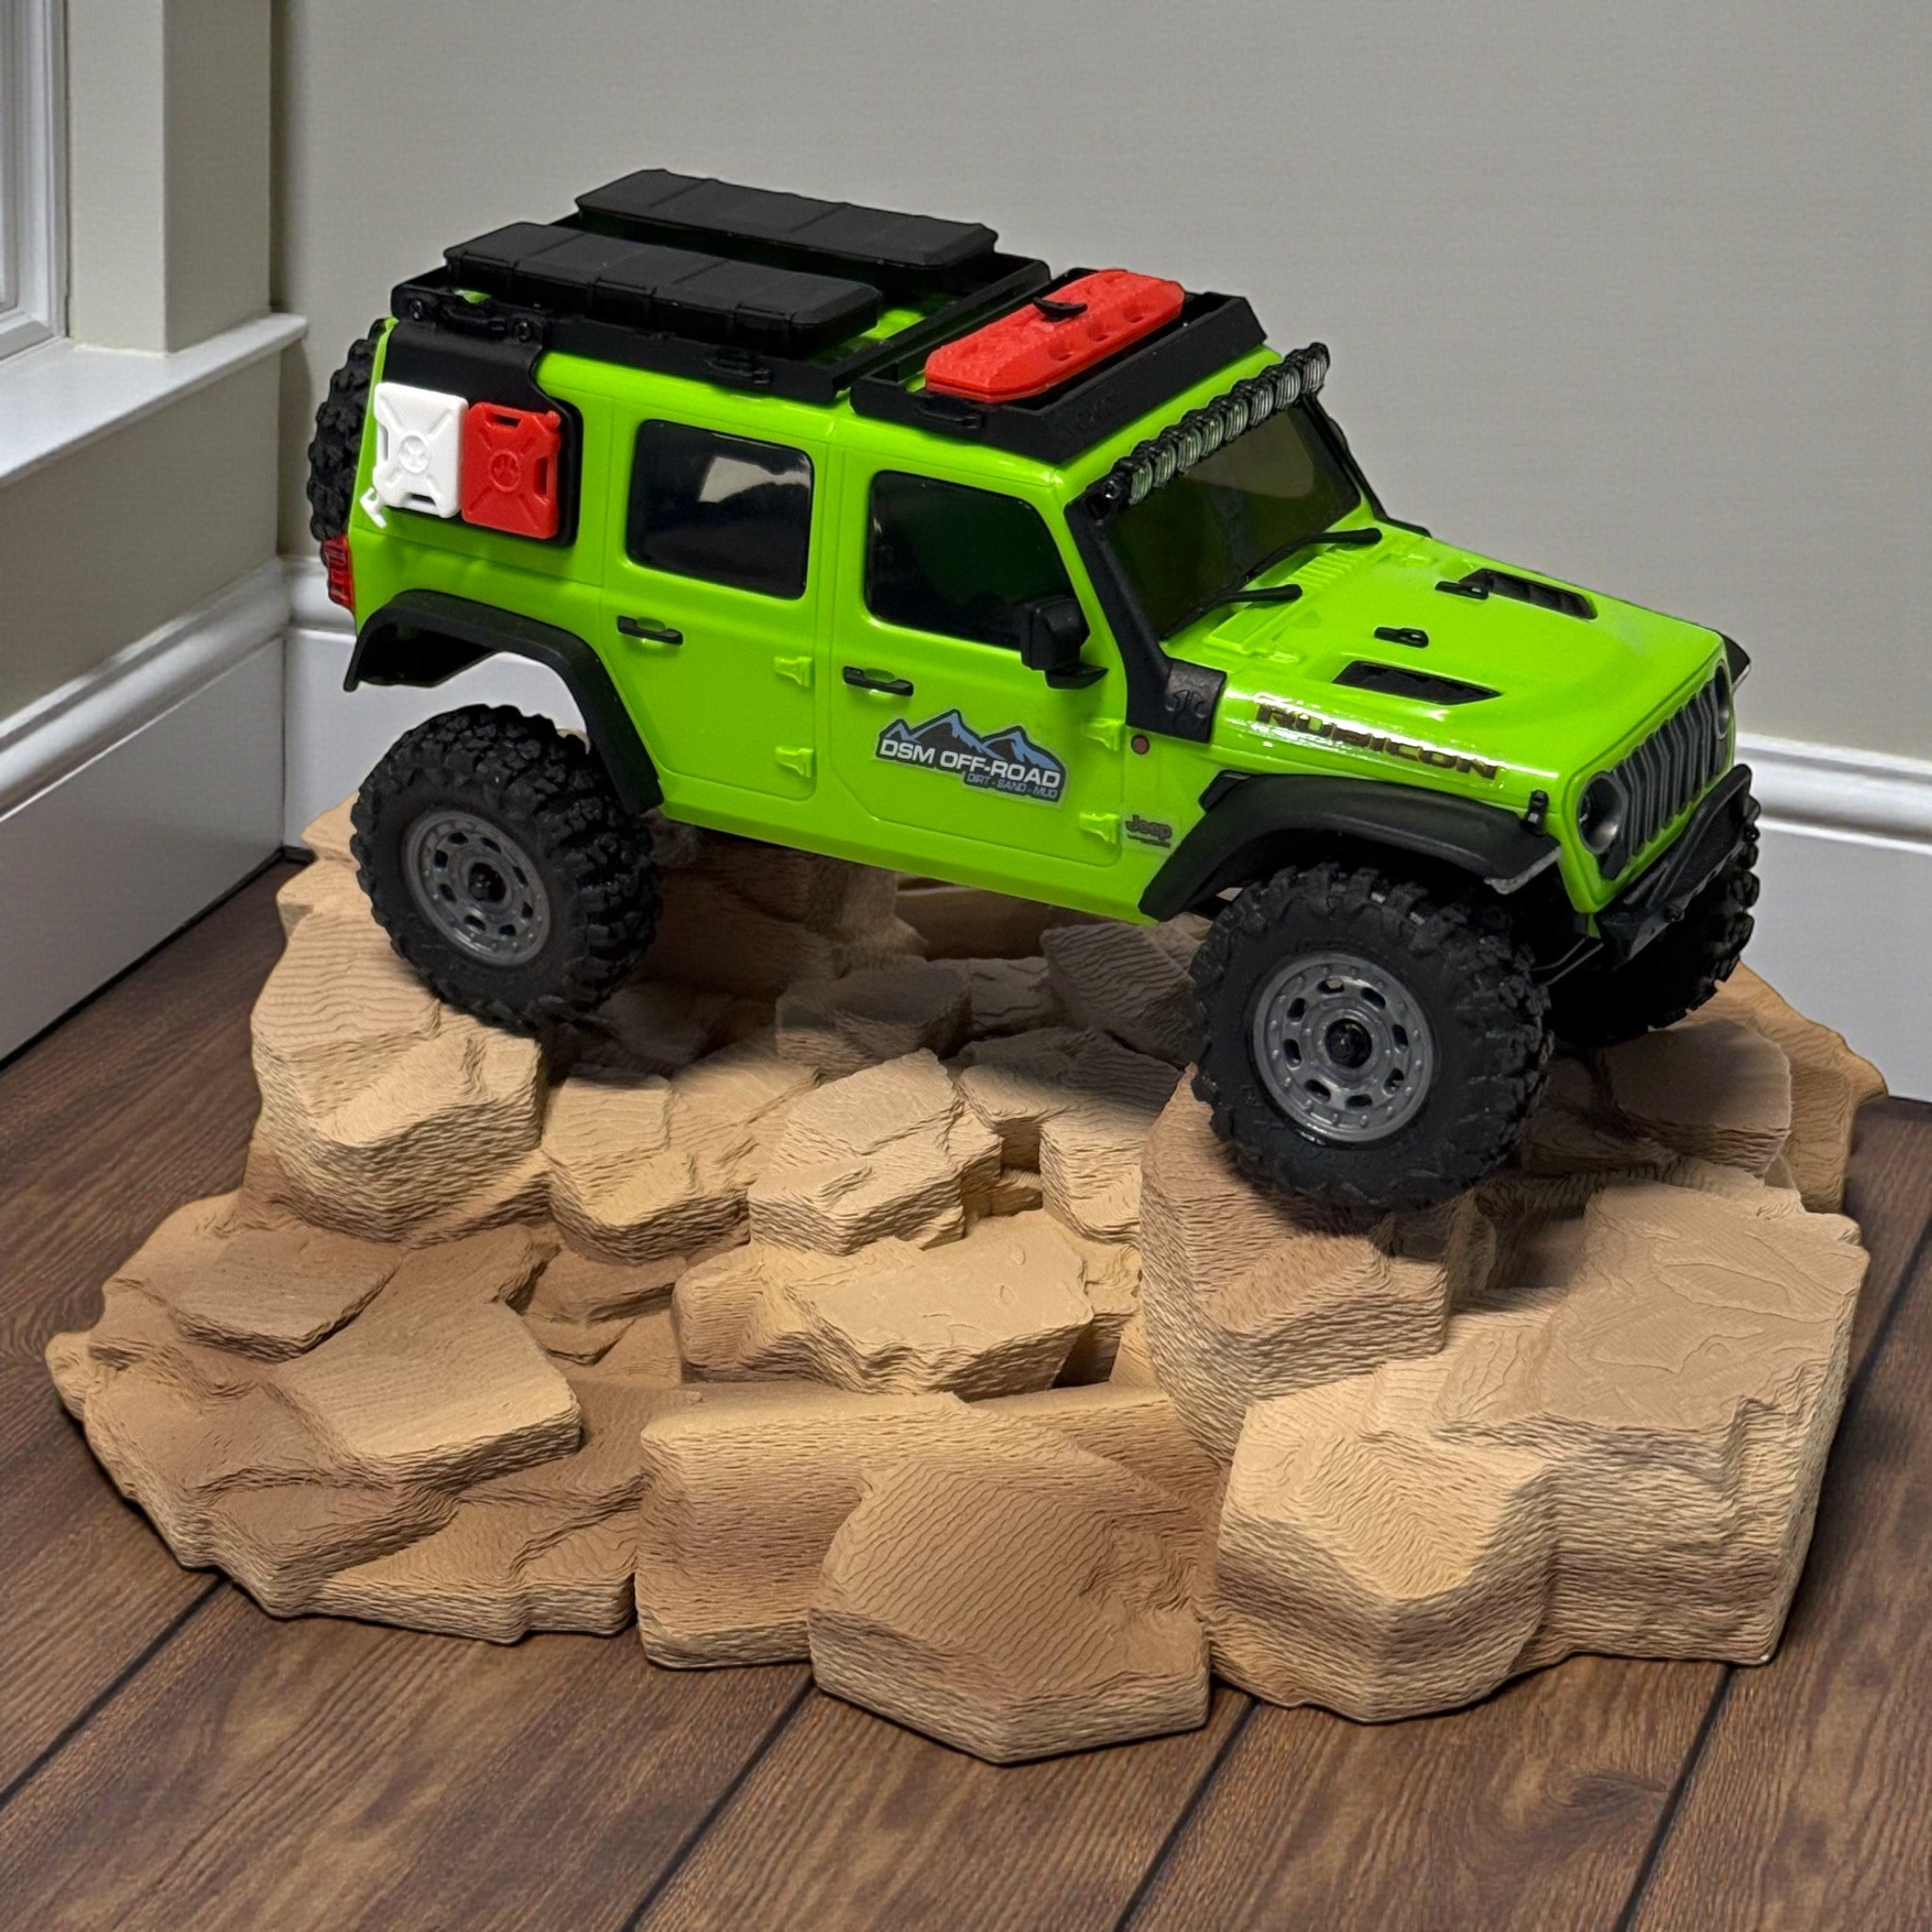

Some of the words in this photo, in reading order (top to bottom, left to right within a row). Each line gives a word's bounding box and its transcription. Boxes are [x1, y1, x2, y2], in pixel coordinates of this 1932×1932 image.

[879, 738, 936, 765] DSM
[939, 750, 1061, 789] OFF-ROAD
[967, 773, 991, 785] DIRT
[997, 779, 1027, 792] SAND
[1033, 785, 1058, 798] MUD
